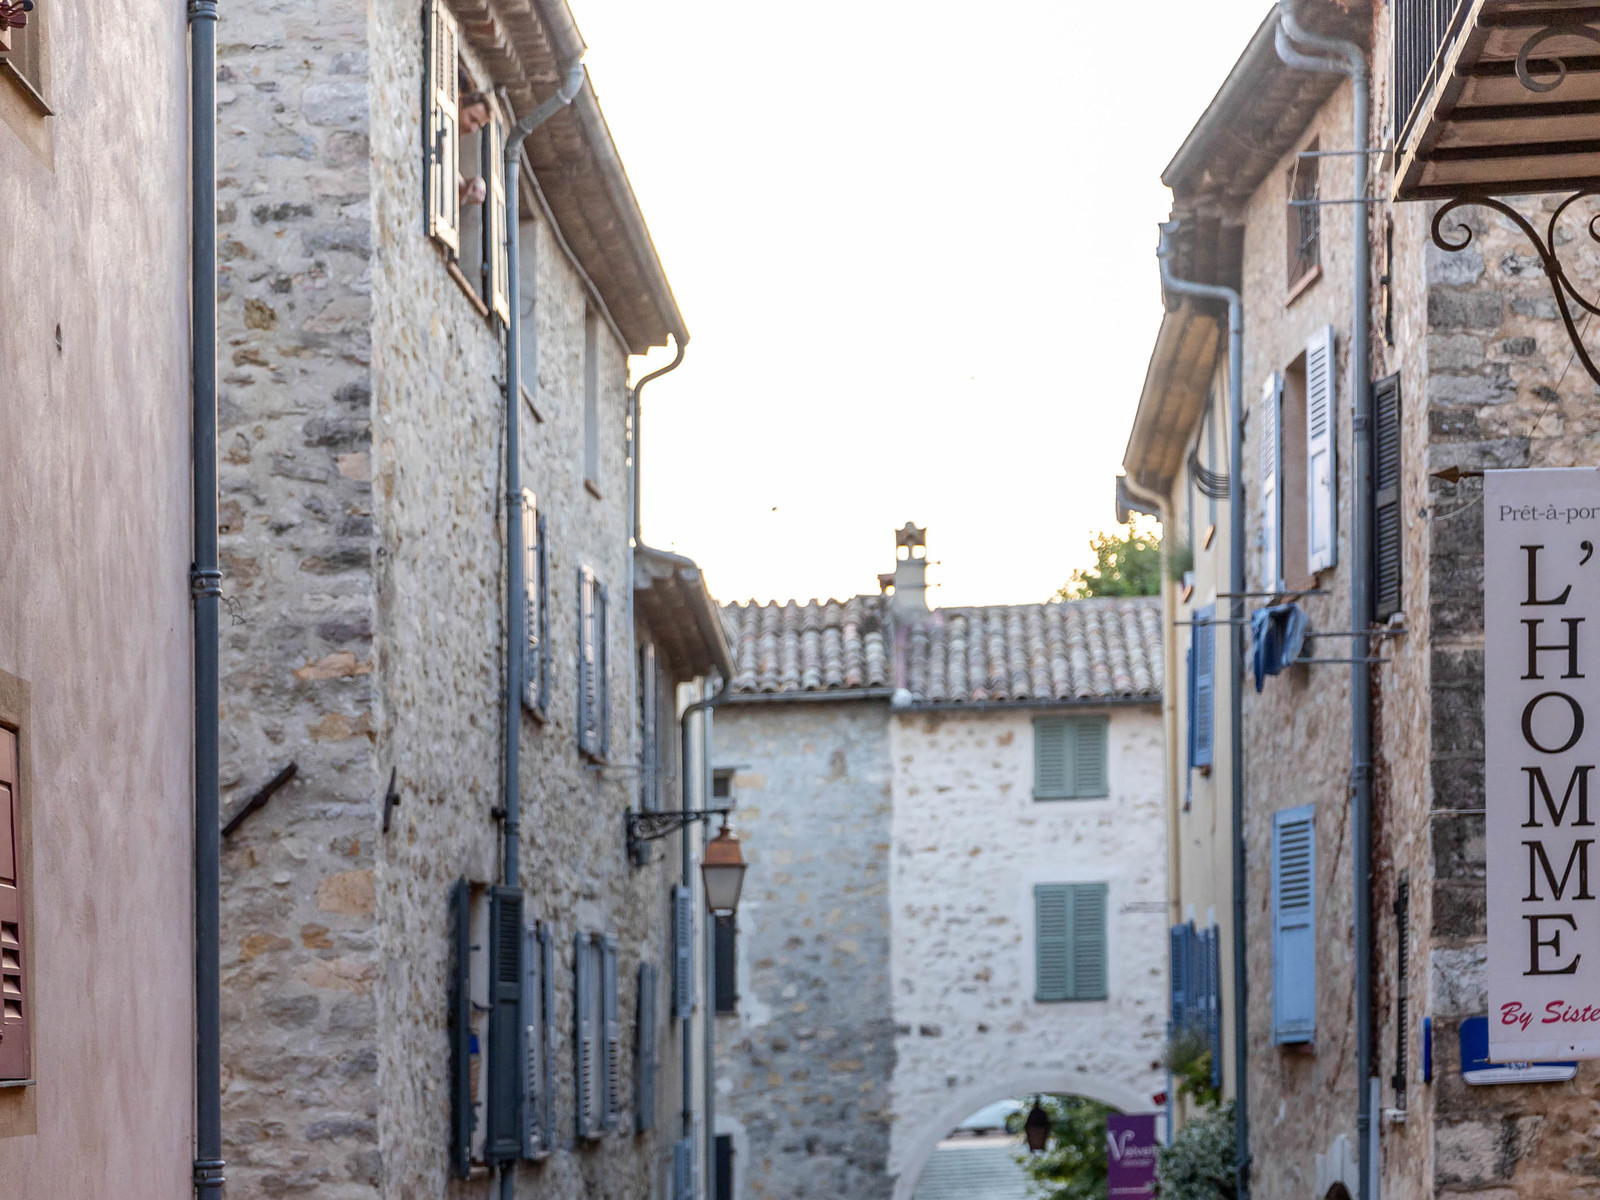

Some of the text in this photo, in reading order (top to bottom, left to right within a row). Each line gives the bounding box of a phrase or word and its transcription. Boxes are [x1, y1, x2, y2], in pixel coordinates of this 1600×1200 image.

[1519, 540, 1596, 976] L'HOMME
[1500, 1000, 1600, 1032] By Siste
